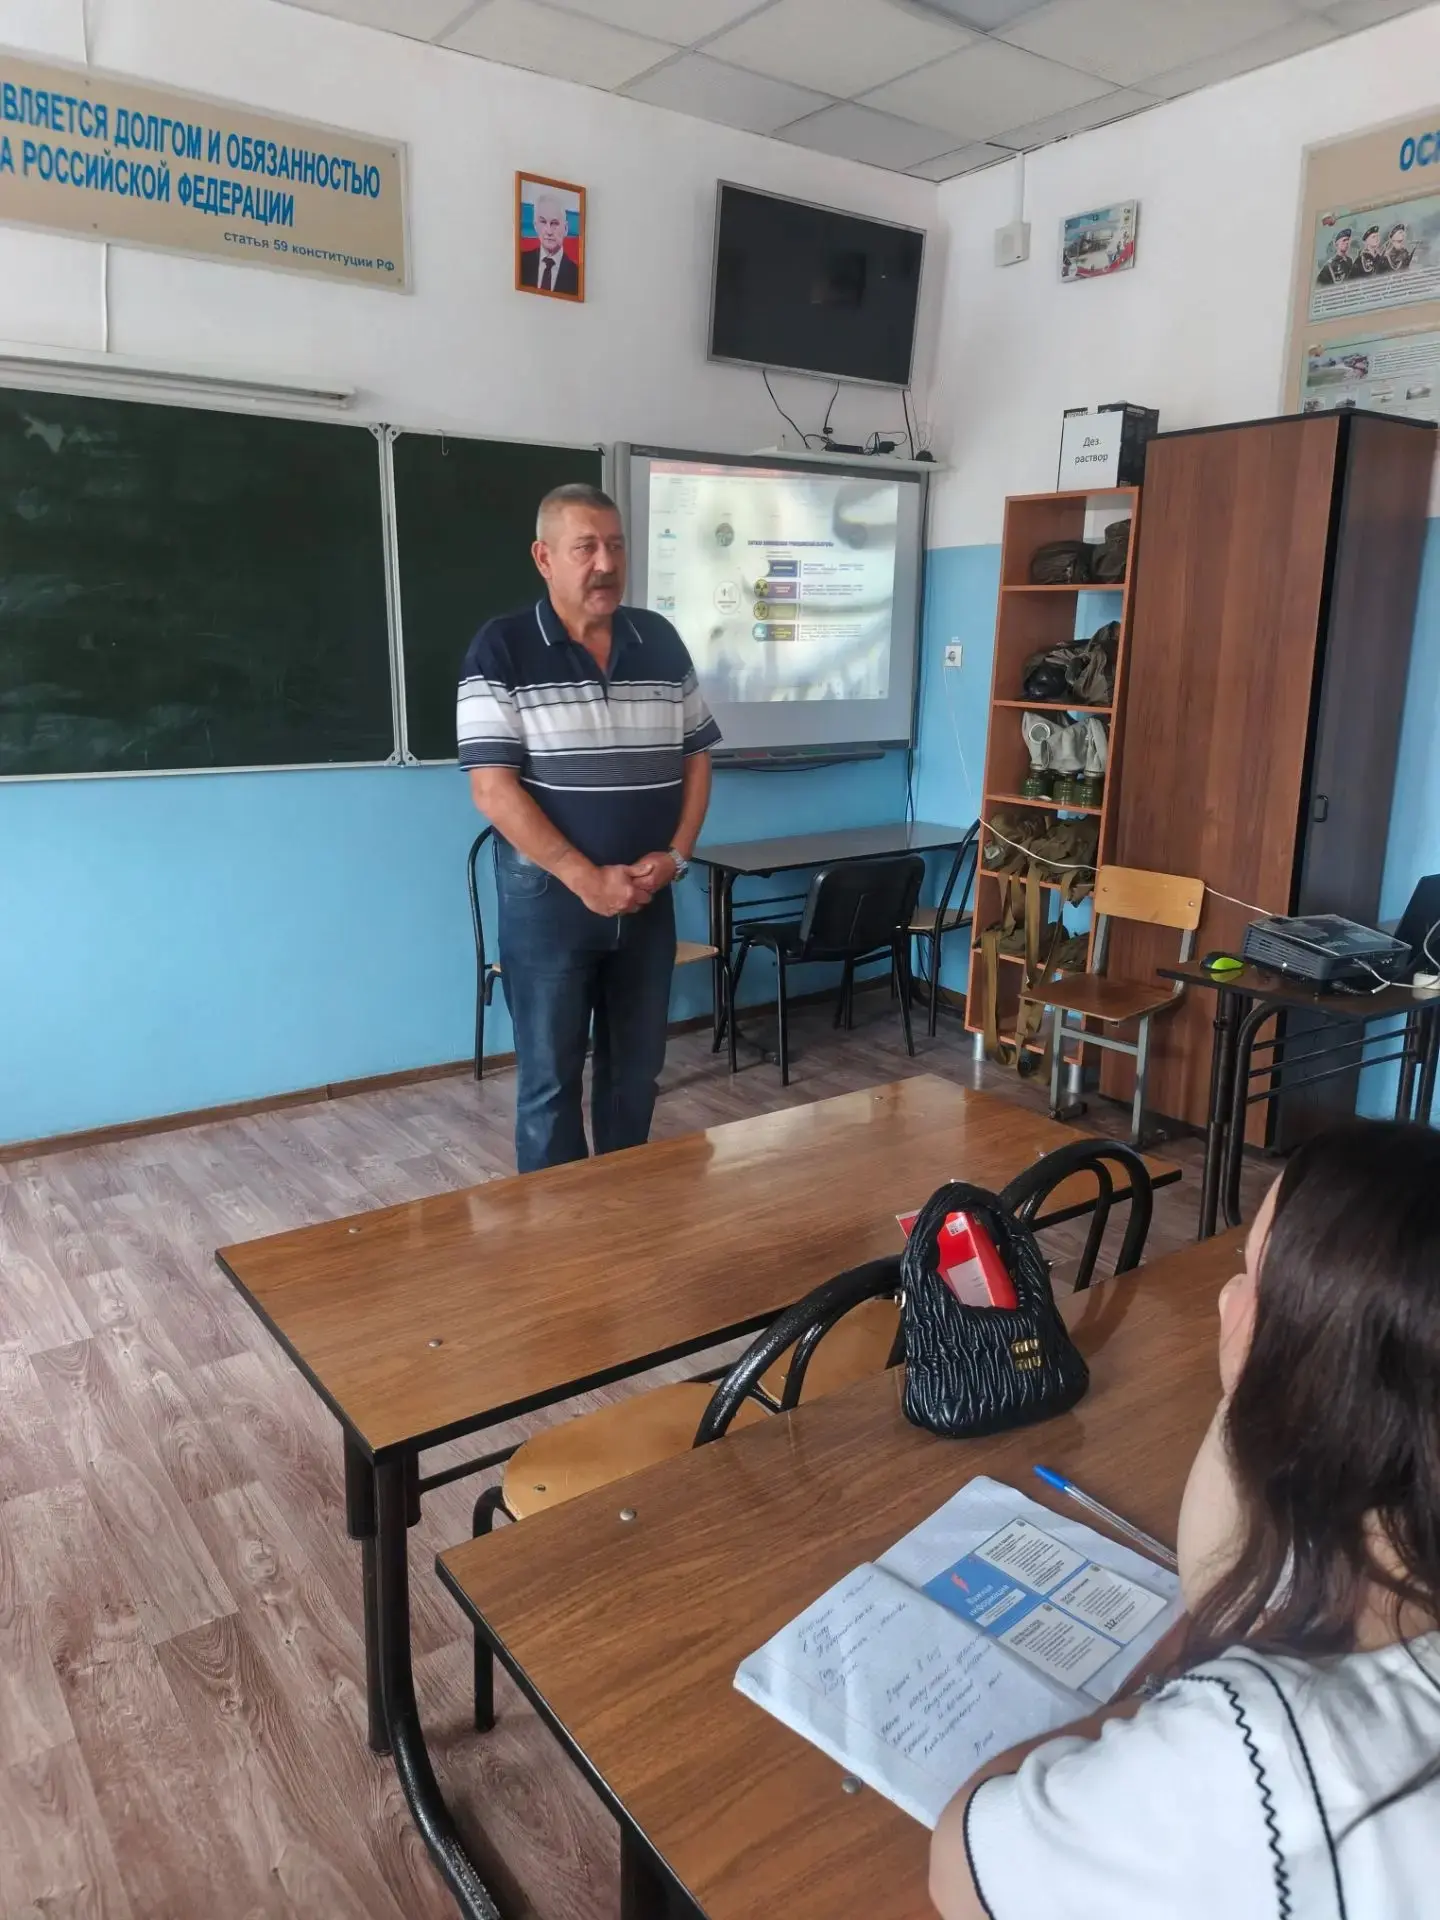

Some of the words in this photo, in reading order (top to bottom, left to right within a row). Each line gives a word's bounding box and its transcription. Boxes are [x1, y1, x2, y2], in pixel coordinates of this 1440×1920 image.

[0, 81, 109, 141] ВЛЯЕТСЯ
[114, 107, 203, 160] ДОЛГОМ
[208, 128, 221, 164] И
[226, 132, 381, 199] ОБЯЗАННОСТЬЮ
[22, 140, 171, 203] РОССИЙСКОЙ
[177, 172, 296, 228] ФЕДЕРАЦИИ
[223, 231, 269, 250] статья
[273, 238, 289, 252] 59
[291, 243, 374, 270] конституции
[376, 257, 396, 273] РФ
[1082, 436, 1102, 448] Дез.
[1074, 453, 1109, 466] раствор
[1103, 1618, 1119, 1631] 112
